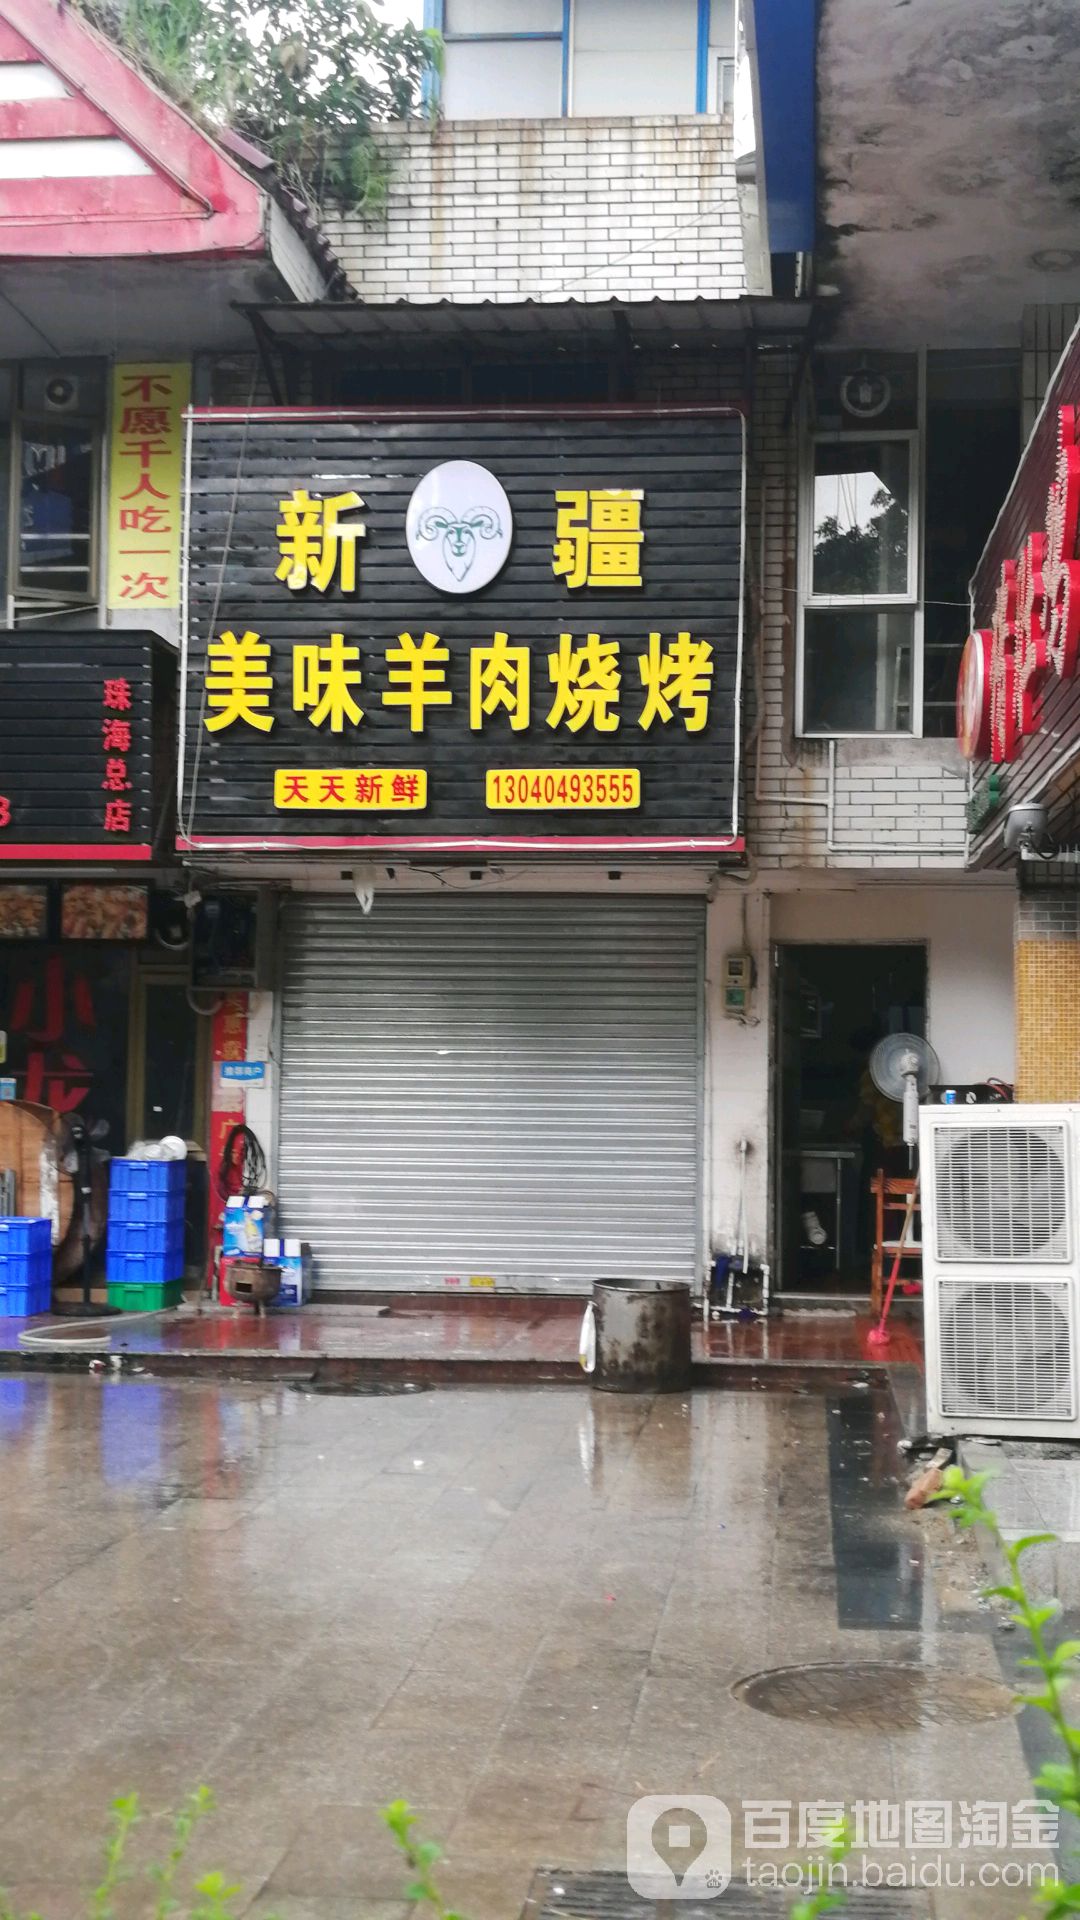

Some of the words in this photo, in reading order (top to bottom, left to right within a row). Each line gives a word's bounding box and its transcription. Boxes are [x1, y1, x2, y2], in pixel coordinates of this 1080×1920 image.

[118, 374, 173, 600] 不愿千人吃一次
[203, 630, 714, 733] 美味羊肉烧烤
[102, 677, 132, 832] 珠海总店
[283, 774, 420, 803] 天天新鲜
[492, 774, 633, 804] 13040493555
